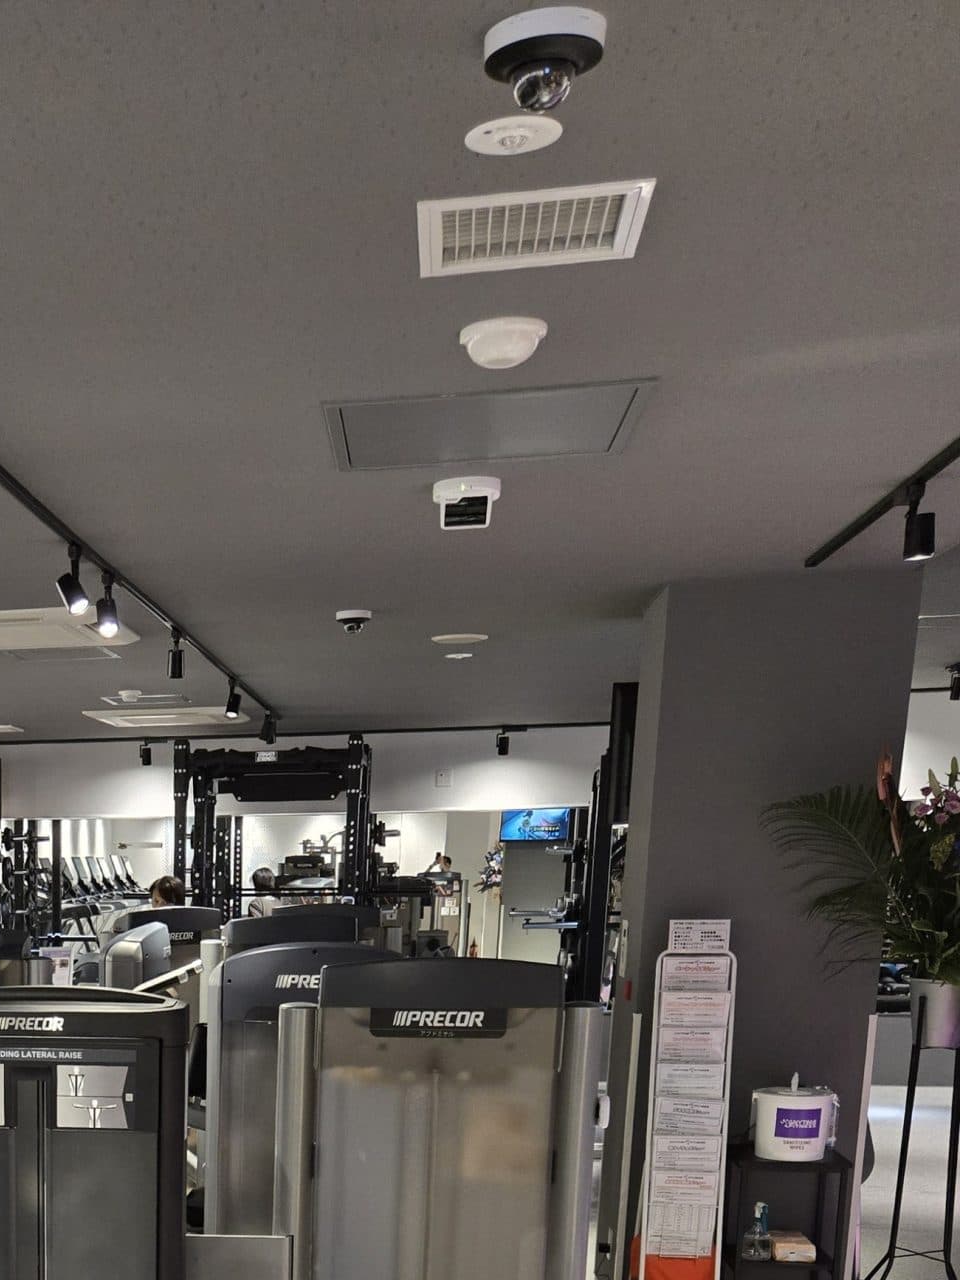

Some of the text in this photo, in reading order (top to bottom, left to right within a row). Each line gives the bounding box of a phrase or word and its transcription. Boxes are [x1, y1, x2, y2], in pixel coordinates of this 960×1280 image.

[286, 974, 321, 989] PRE
[5, 1016, 65, 1031] PRECOR
[405, 1010, 485, 1027] PRECOR
[21, 1050, 58, 1059] LATERAL
[58, 1051, 83, 1060] RAISE
